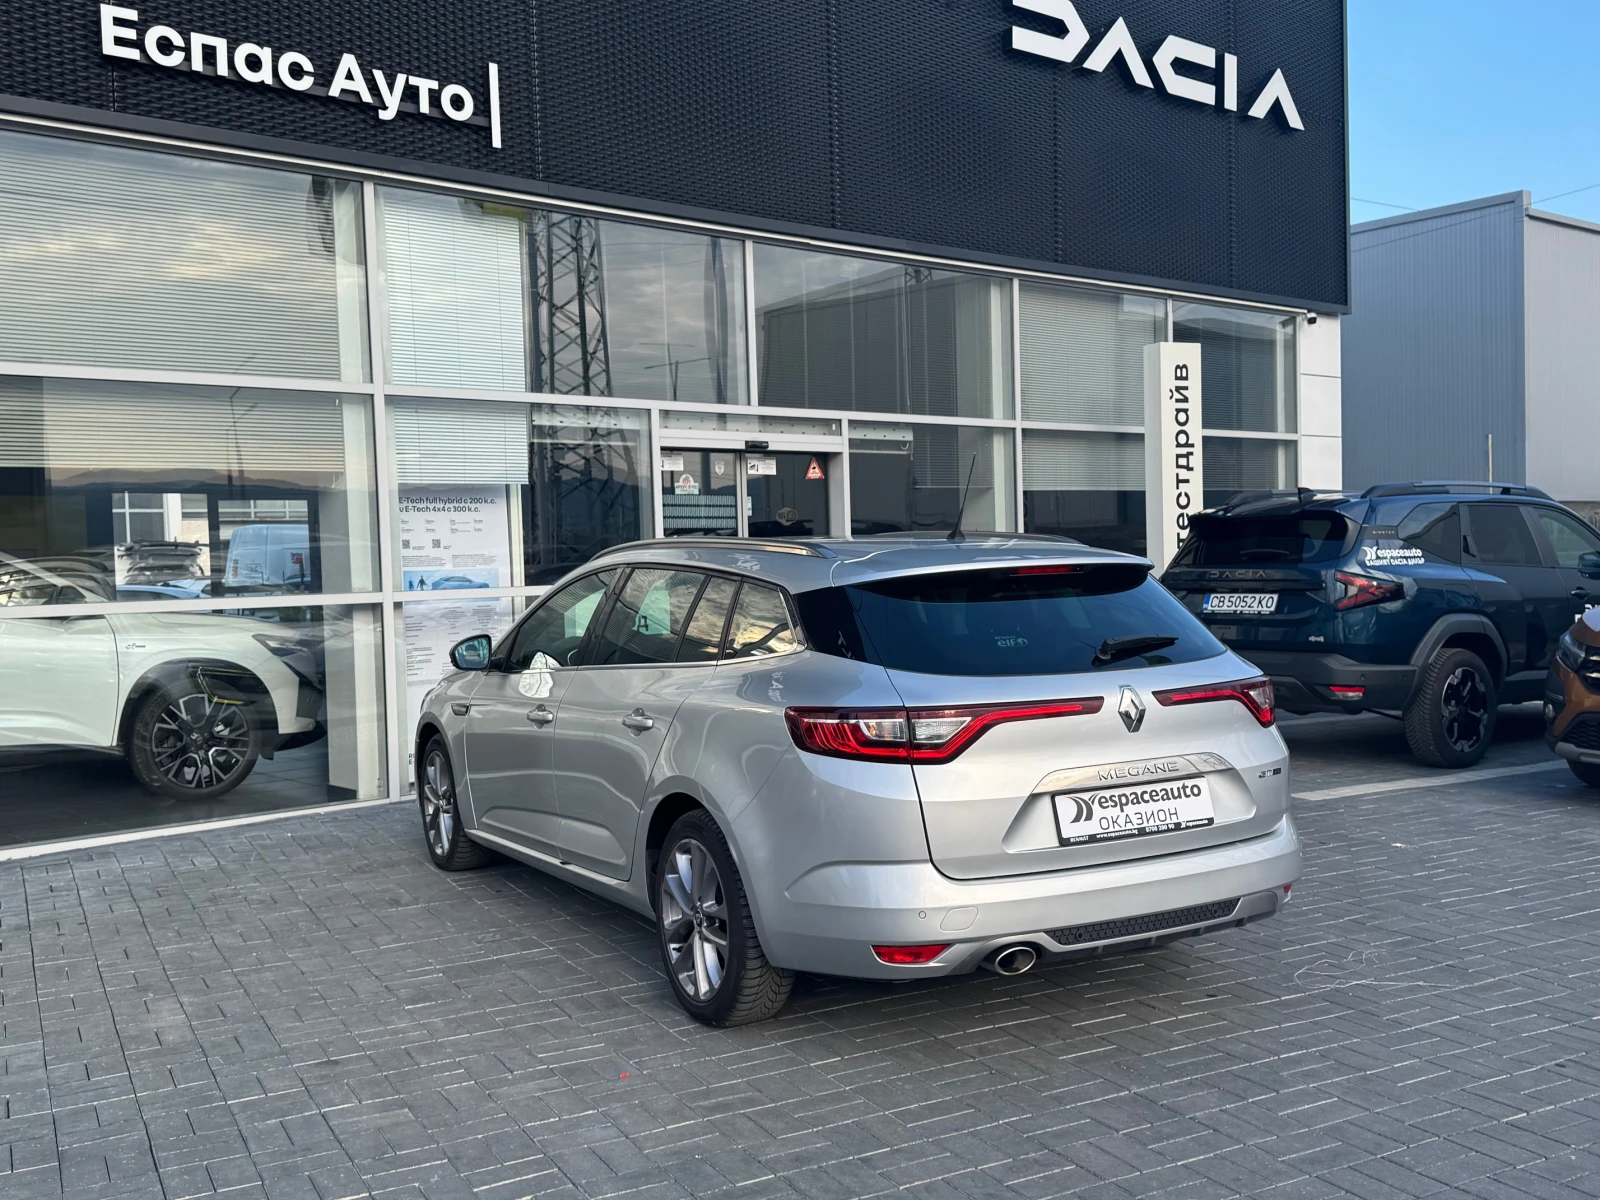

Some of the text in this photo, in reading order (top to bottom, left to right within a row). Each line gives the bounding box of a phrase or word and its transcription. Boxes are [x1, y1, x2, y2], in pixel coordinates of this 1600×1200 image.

[100, 3, 474, 120] Еспас Ауто
[1012, 0, 1304, 131] DACIA
[425, 496, 439, 504] full
[440, 496, 463, 505] hybrid
[1377, 547, 1422, 559] espaceauto
[1210, 570, 1266, 578] DACIA
[1097, 761, 1180, 782] MEGANE
[1098, 781, 1202, 812] espaceauto
[1099, 807, 1180, 831] ОКАЗИОН
